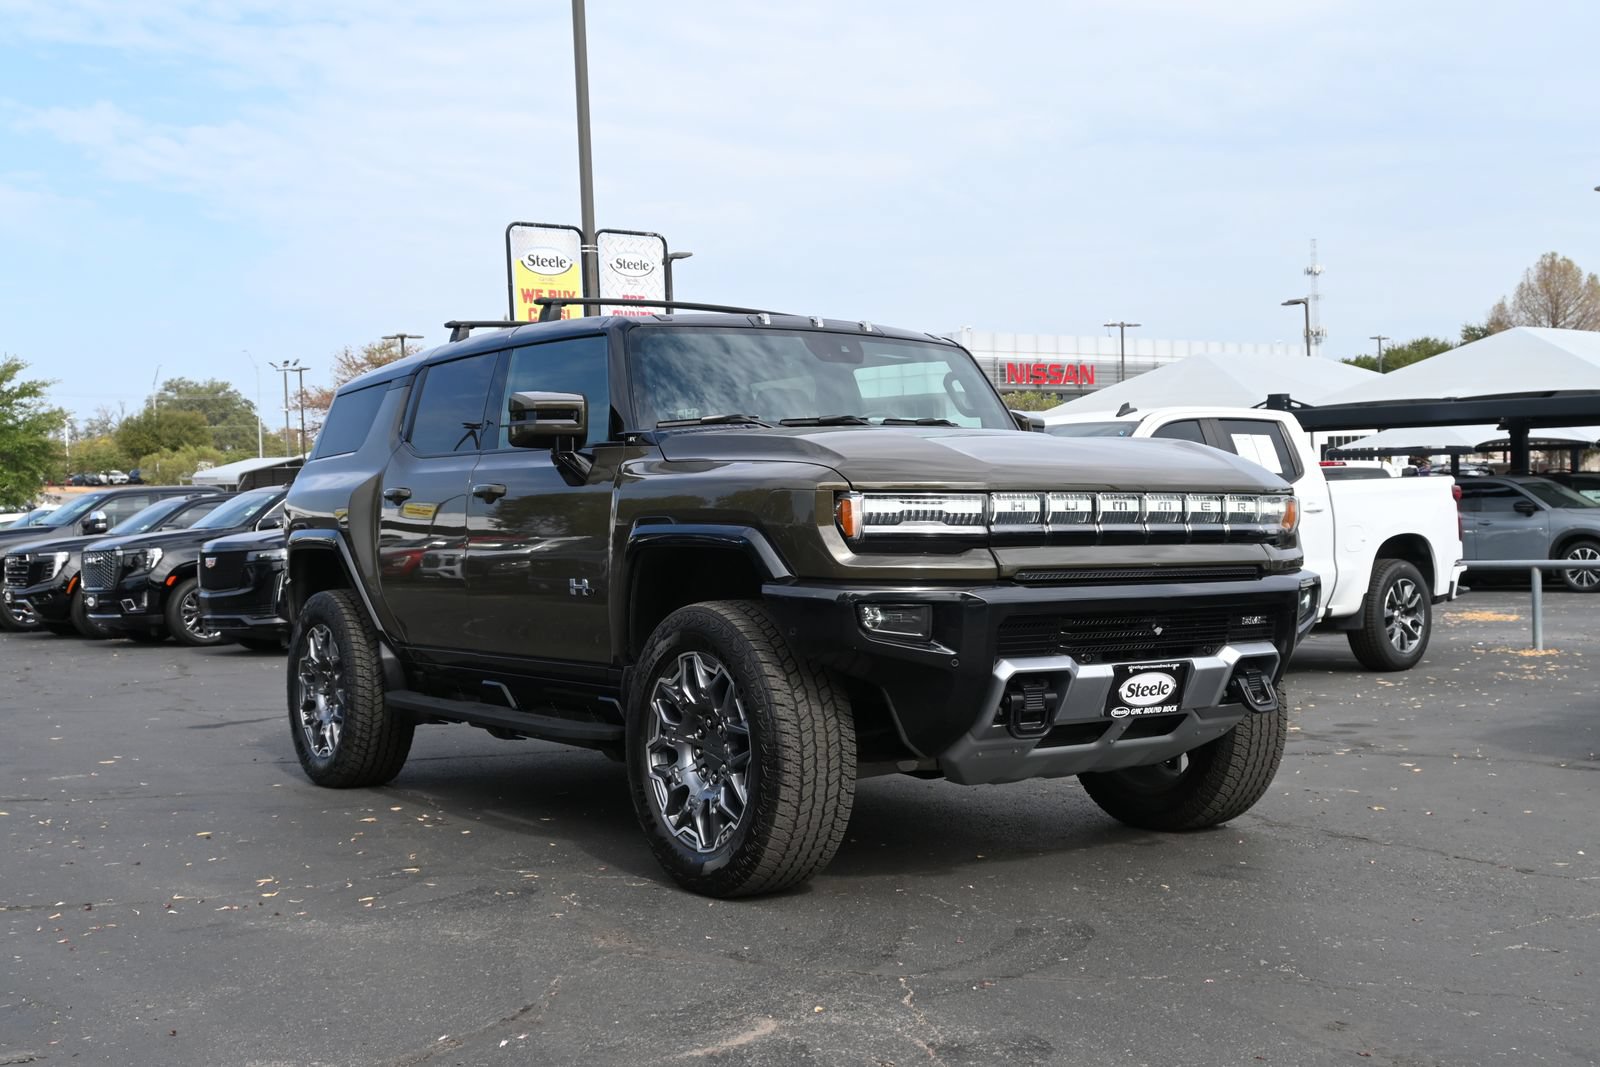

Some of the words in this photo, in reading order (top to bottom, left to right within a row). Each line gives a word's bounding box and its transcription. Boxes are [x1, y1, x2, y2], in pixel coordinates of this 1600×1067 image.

[527, 254, 567, 269] Steele
[615, 257, 650, 271] Steele
[528, 308, 571, 323] CS!
[1006, 362, 1095, 385] NISSAN
[1125, 681, 1169, 698] Steele
[1162, 704, 1178, 712] ROCK
